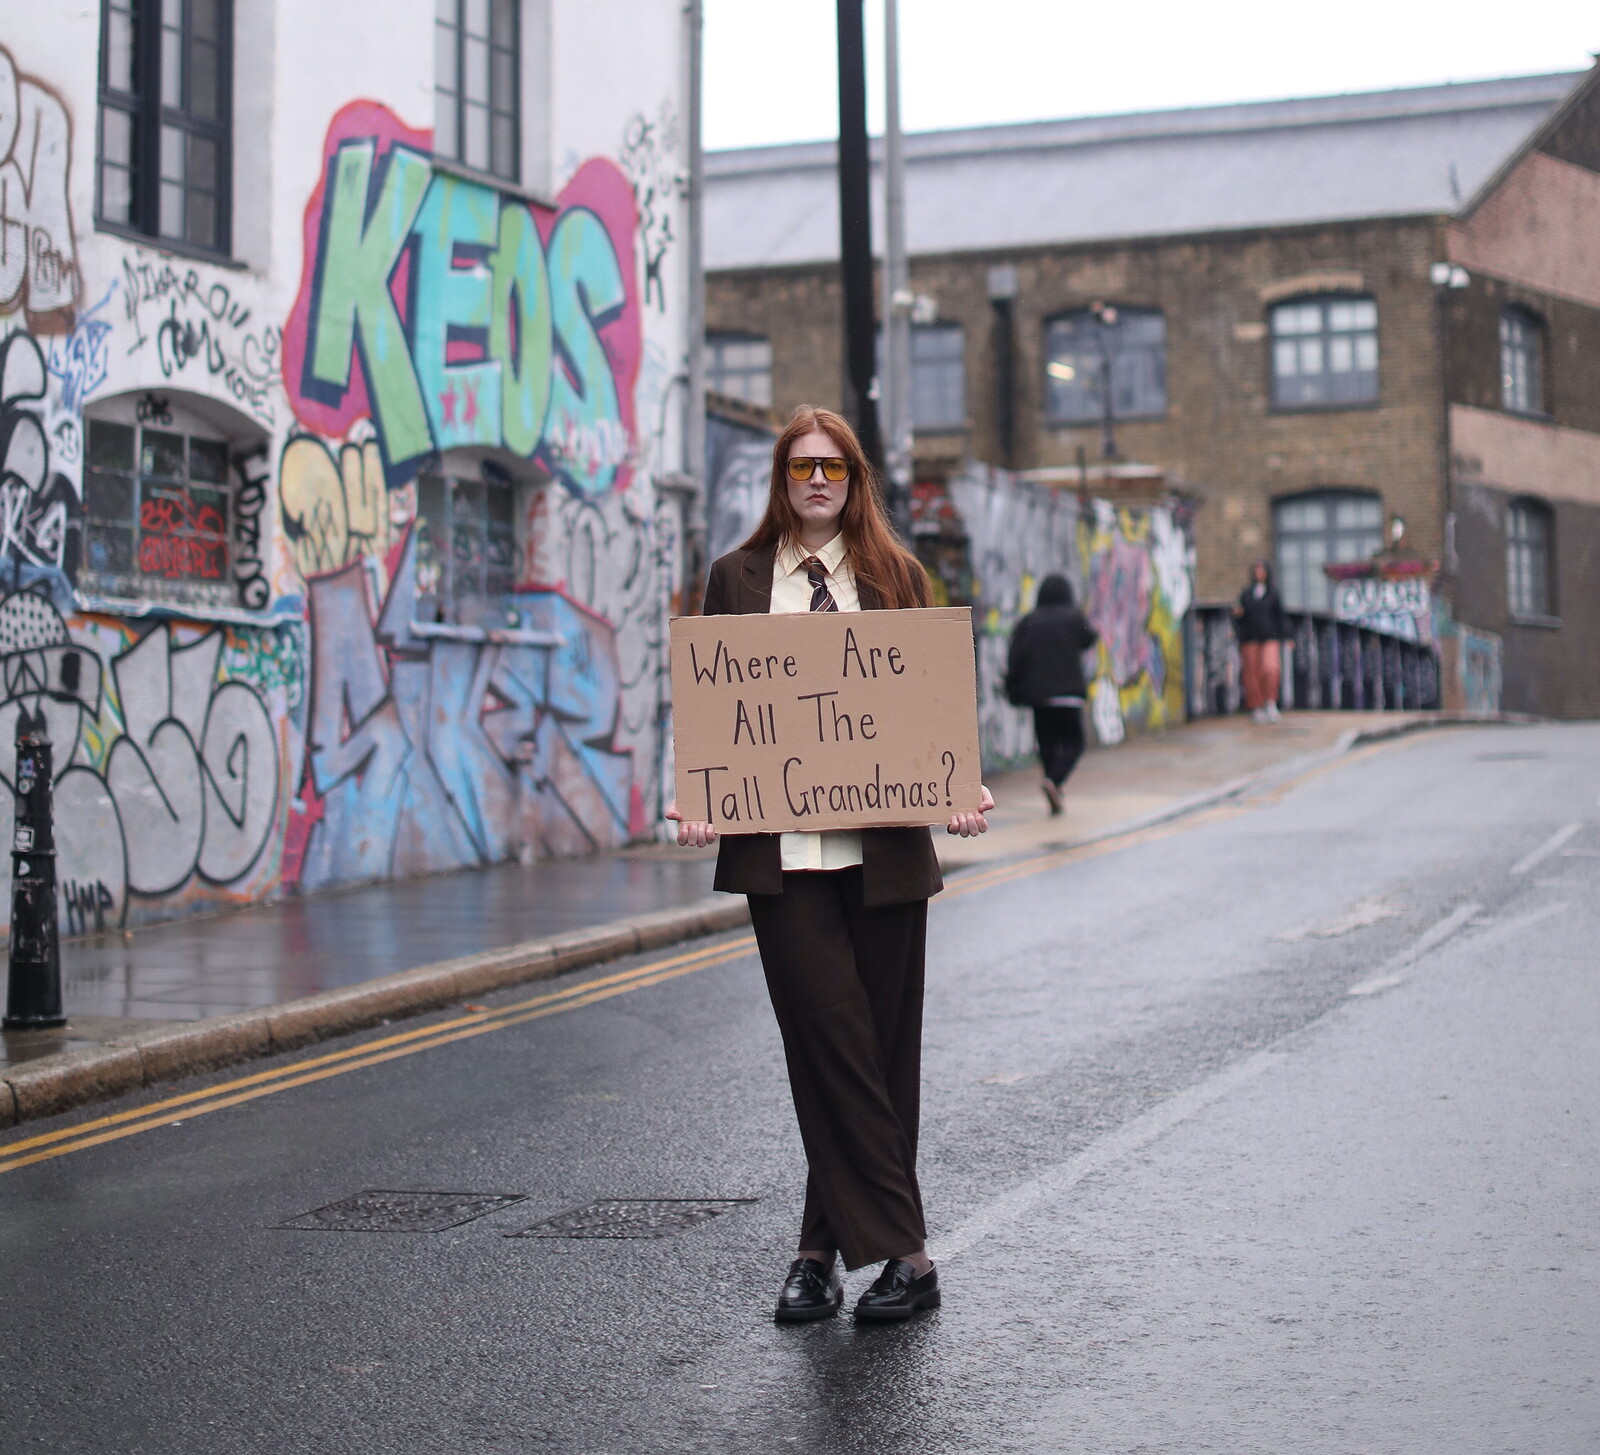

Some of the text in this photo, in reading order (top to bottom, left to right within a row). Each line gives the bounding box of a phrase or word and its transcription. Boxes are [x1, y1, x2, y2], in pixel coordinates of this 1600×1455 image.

[300, 135, 627, 499] KEOS
[689, 627, 905, 686] Where Are
[733, 690, 877, 746] All The
[687, 750, 956, 825] Tall Grandmas?
